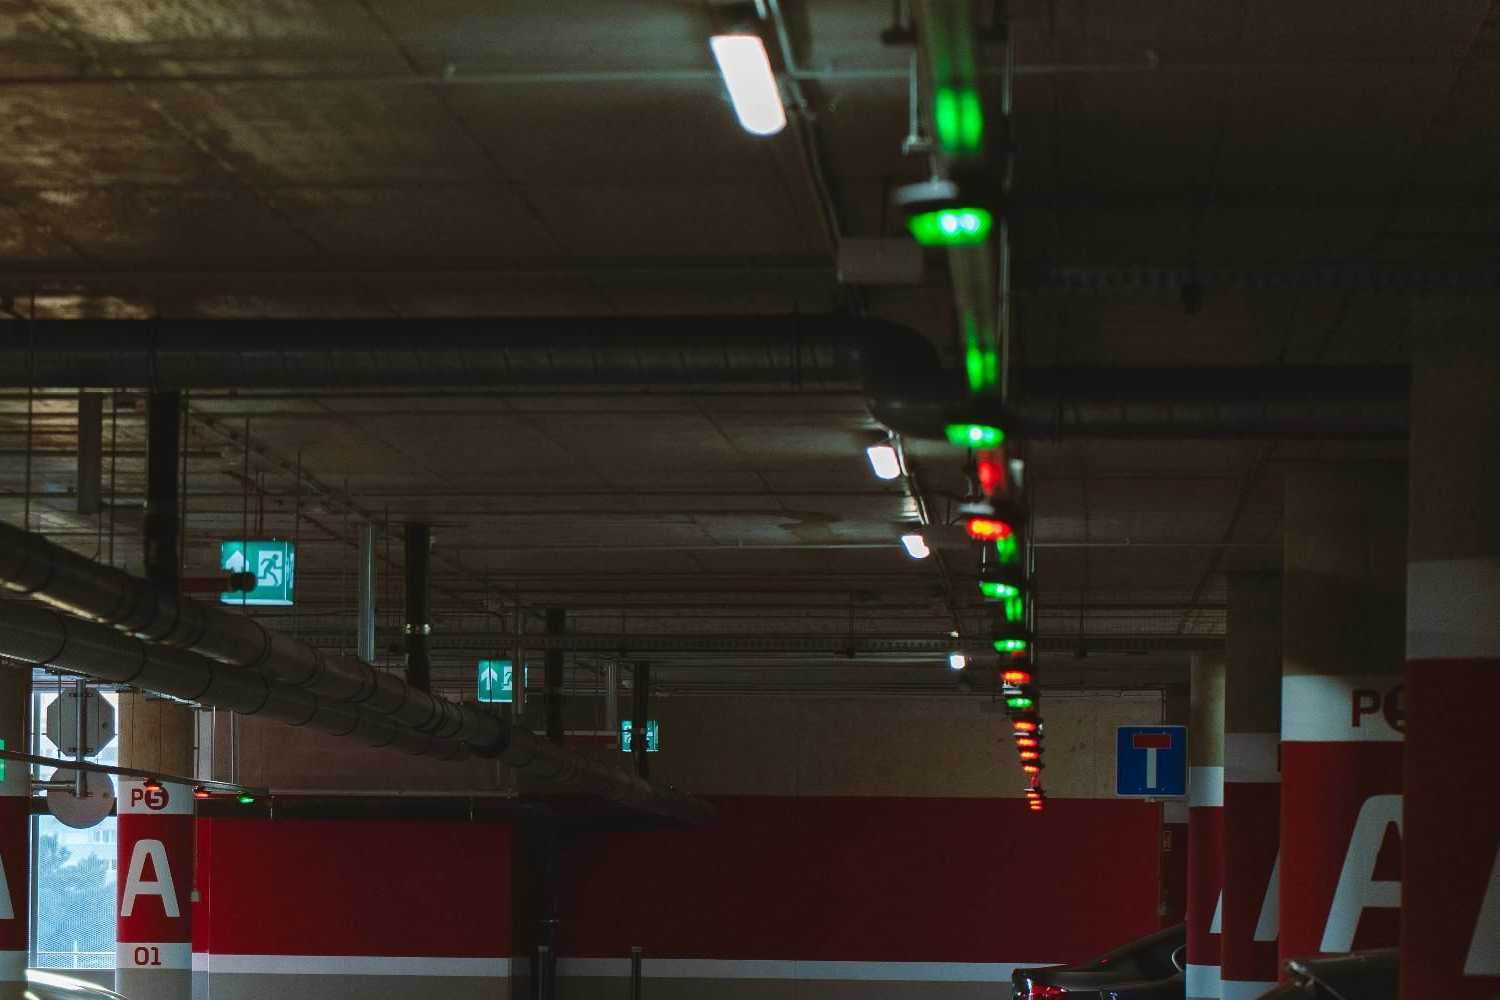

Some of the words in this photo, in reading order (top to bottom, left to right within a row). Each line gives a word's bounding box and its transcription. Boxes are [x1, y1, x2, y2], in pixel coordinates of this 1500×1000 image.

[131, 786, 168, 809] P5
[120, 839, 181, 918] A
[1319, 794, 1404, 954] A
[133, 946, 162, 966] 01
